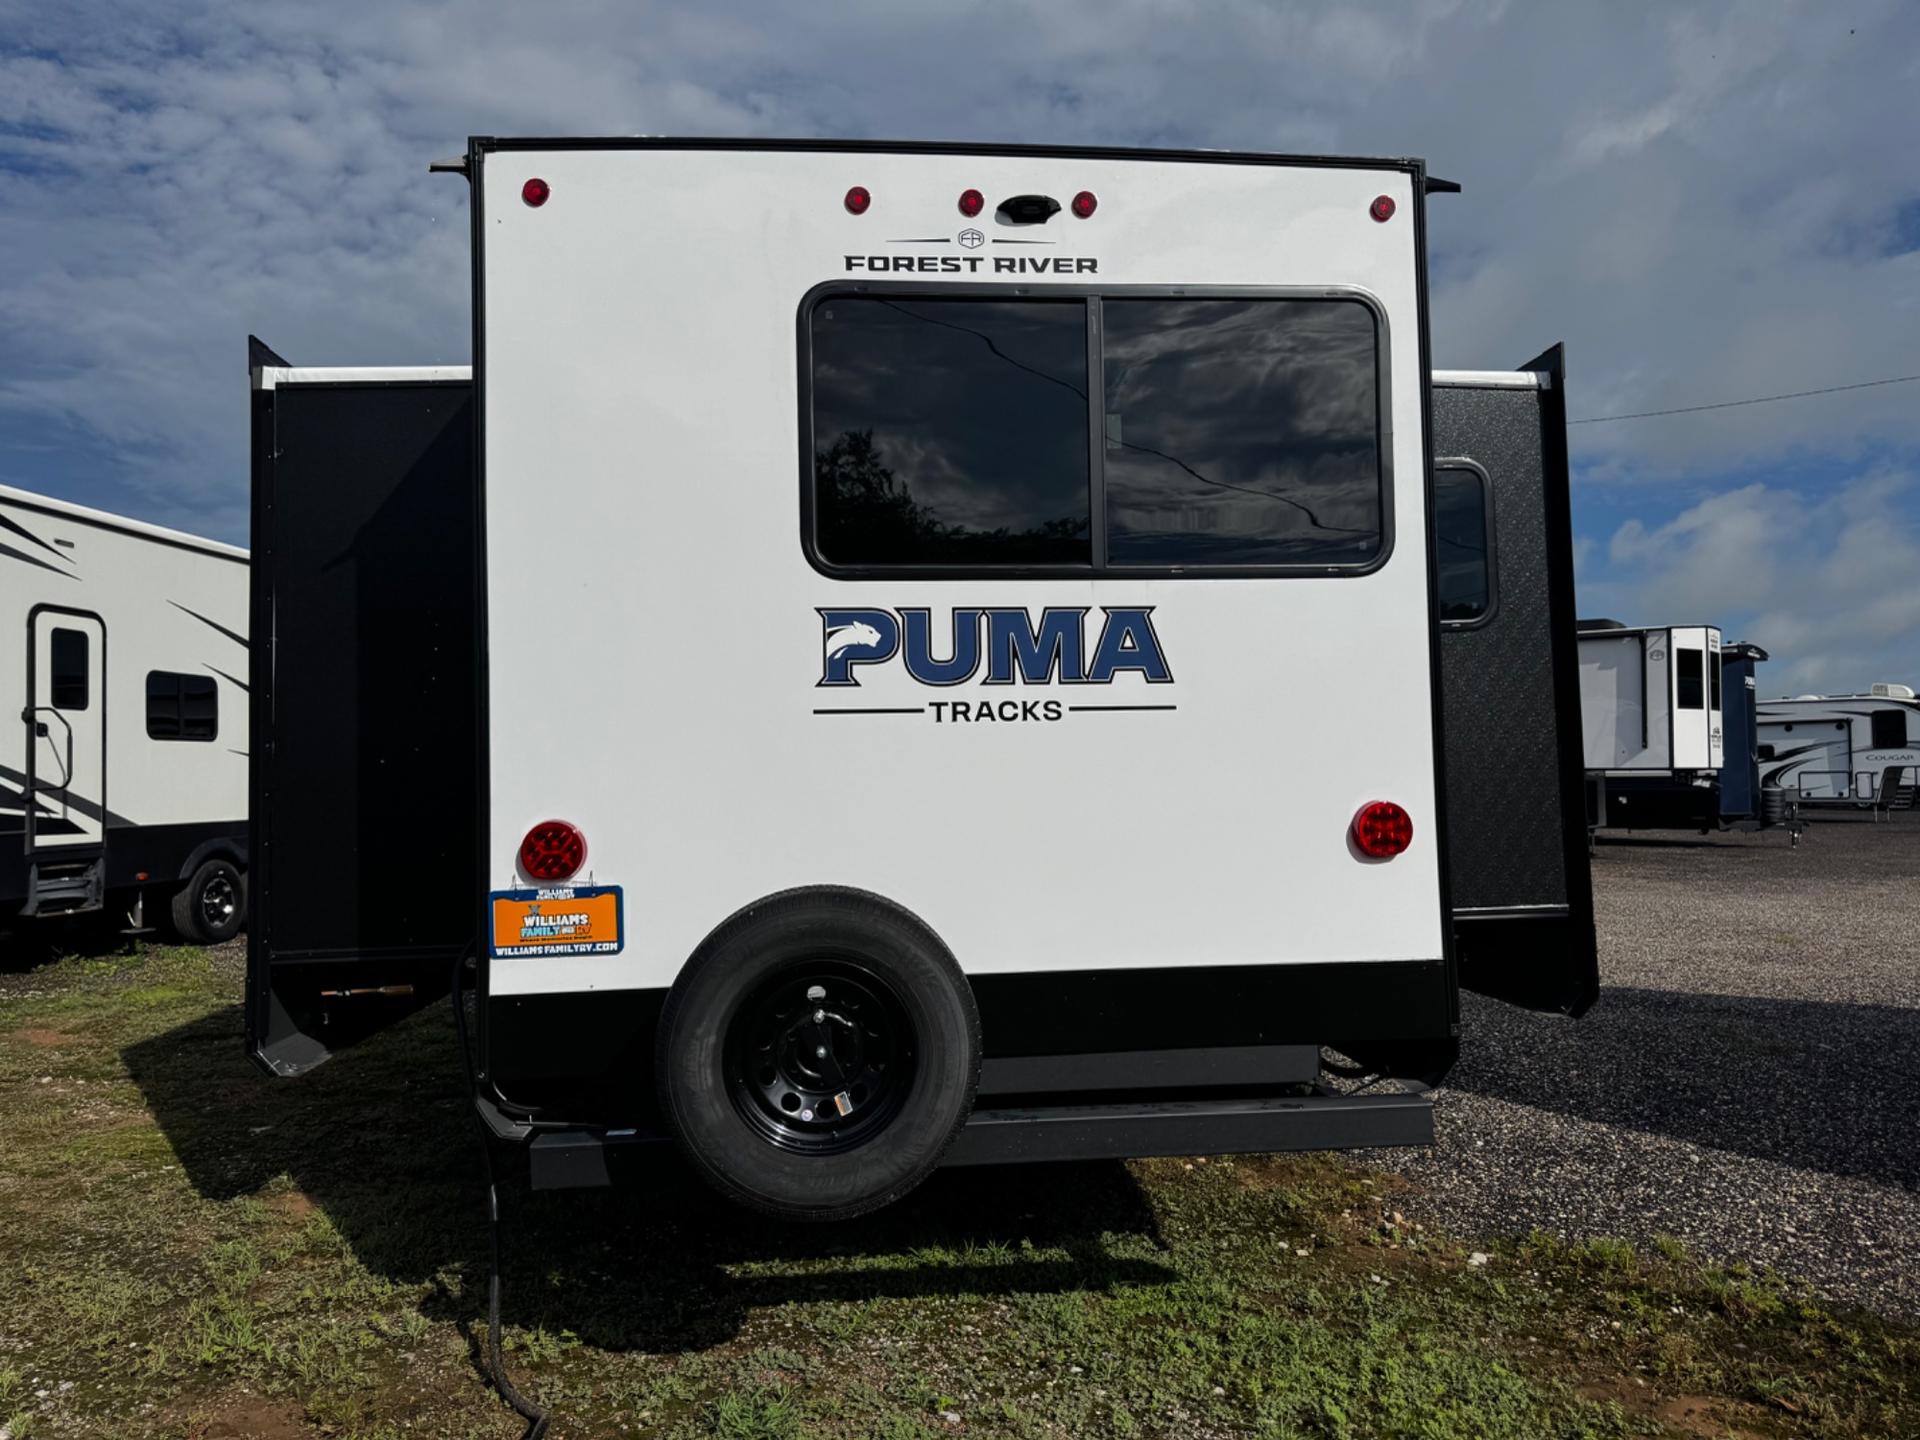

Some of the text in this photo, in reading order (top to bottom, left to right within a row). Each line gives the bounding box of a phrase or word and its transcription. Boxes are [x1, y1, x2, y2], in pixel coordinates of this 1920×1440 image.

[844, 255, 1099, 274] FOREST RIVER
[814, 606, 1175, 687] PUMA
[928, 700, 1063, 723] TRACKS
[523, 914, 589, 927] WILLIAMS
[521, 926, 560, 938] FAMILY
